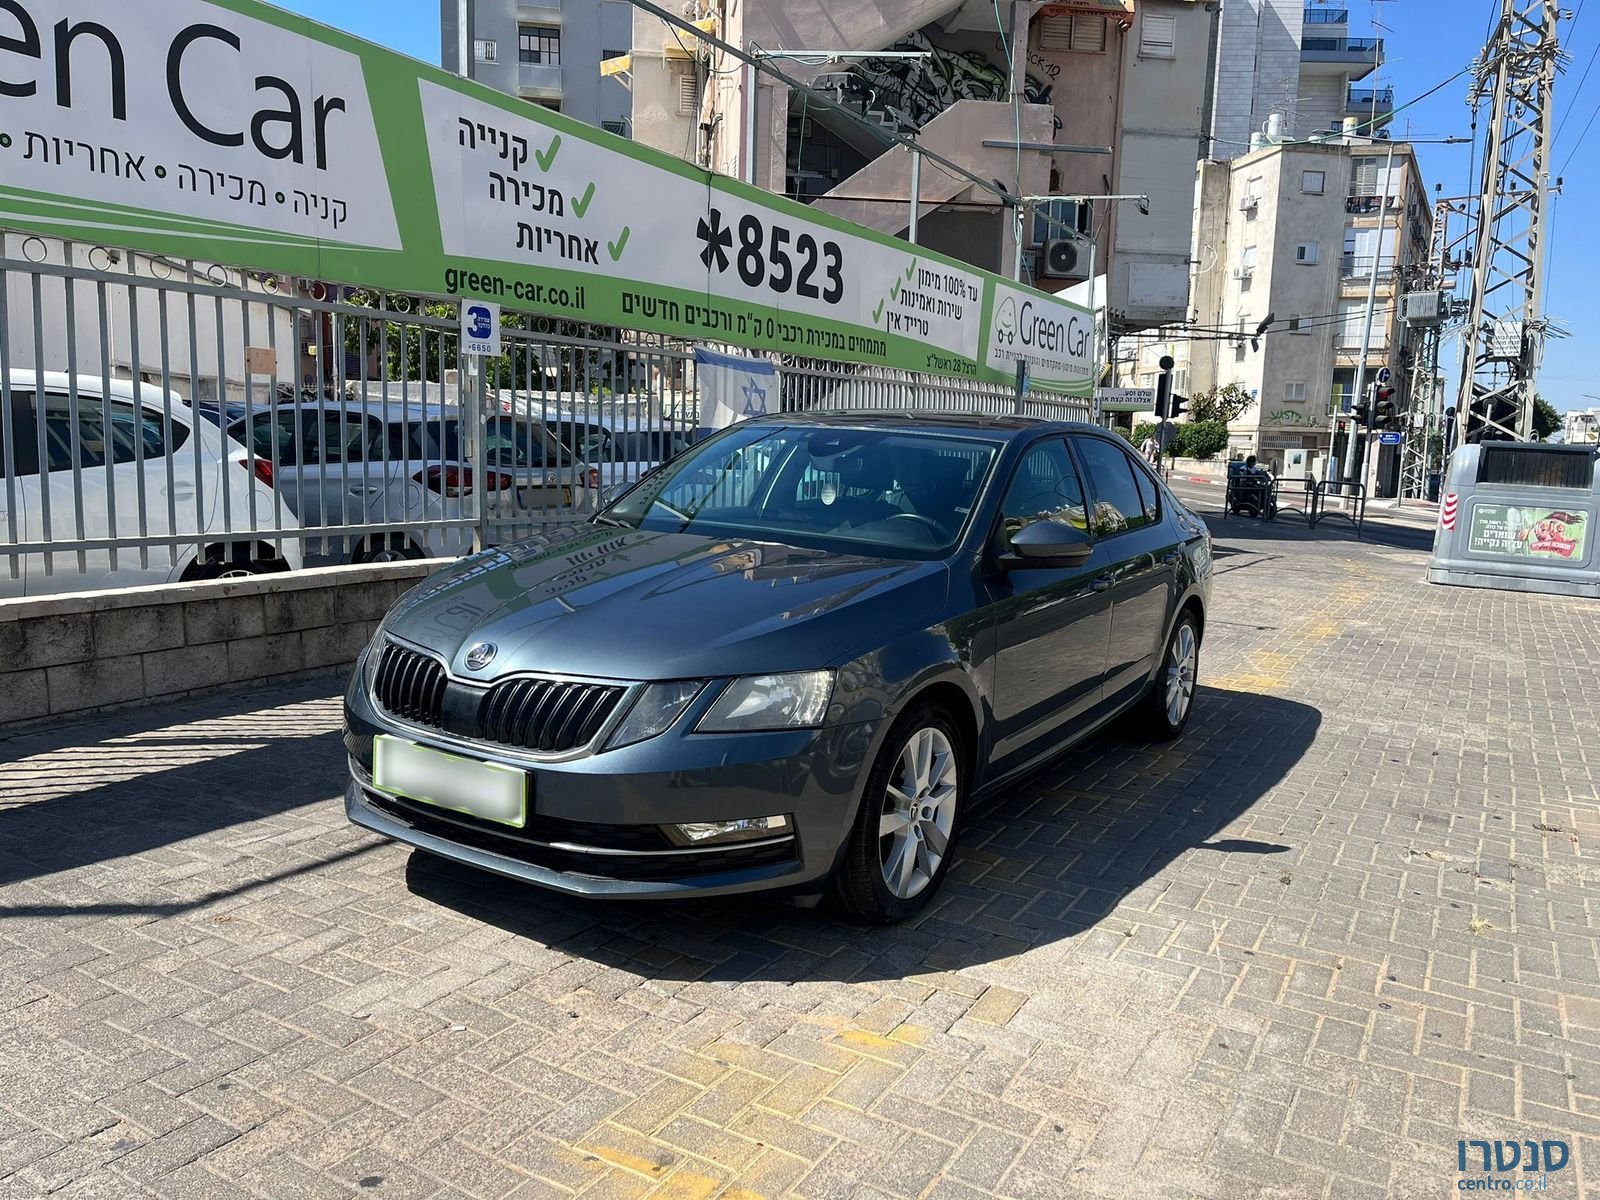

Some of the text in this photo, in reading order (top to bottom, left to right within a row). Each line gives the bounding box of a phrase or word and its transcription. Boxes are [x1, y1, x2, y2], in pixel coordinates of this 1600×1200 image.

[166, 23, 346, 171] Car
[458, 116, 528, 172] קנייה
[23, 131, 347, 229] קניה מכירה אחריות
[489, 171, 564, 217] מכירה
[516, 222, 599, 265] אחריות
[445, 267, 585, 310] green-car.co.il
[900, 288, 962, 320] שירות ואמינות
[918, 268, 978, 302] עד 100% מימון
[622, 292, 887, 356] מתמחים במכירת רכבי 0 ק"מ ורכבים חדשים
[886, 311, 929, 336] טרייד אין
[1020, 301, 1090, 358] Green Car
[953, 358, 961, 373] 28
